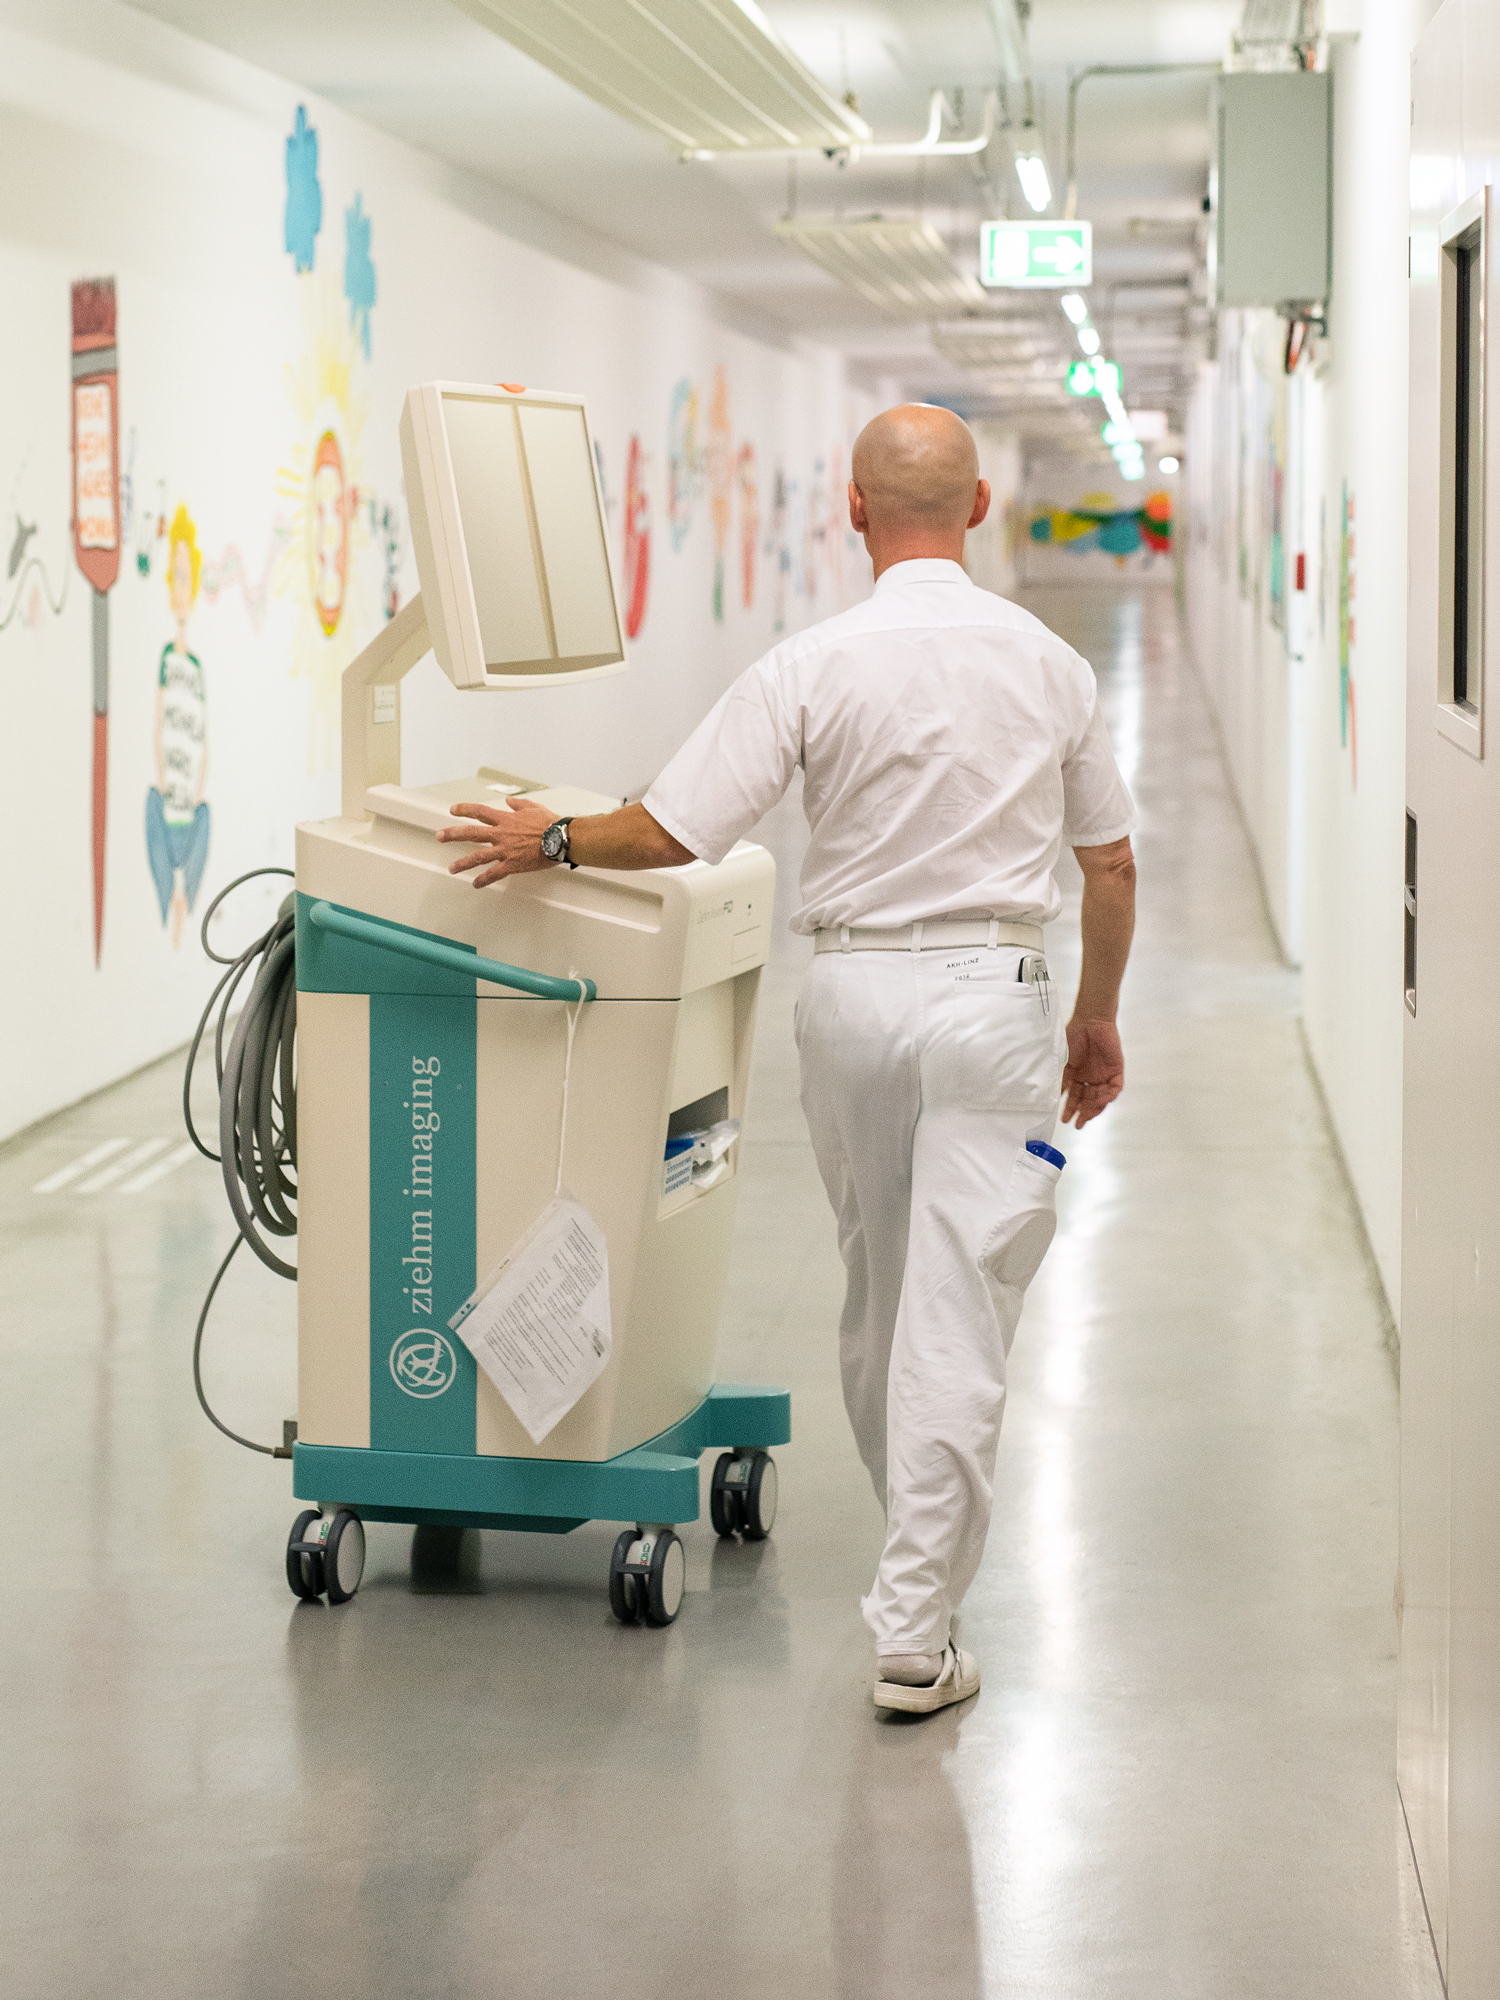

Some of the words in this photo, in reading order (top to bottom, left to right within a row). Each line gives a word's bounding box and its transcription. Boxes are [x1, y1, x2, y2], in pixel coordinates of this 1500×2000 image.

[946, 958, 979, 968] AKH-LINZ
[402, 1056, 441, 1198] imaging
[402, 1209, 433, 1315] ziehm
